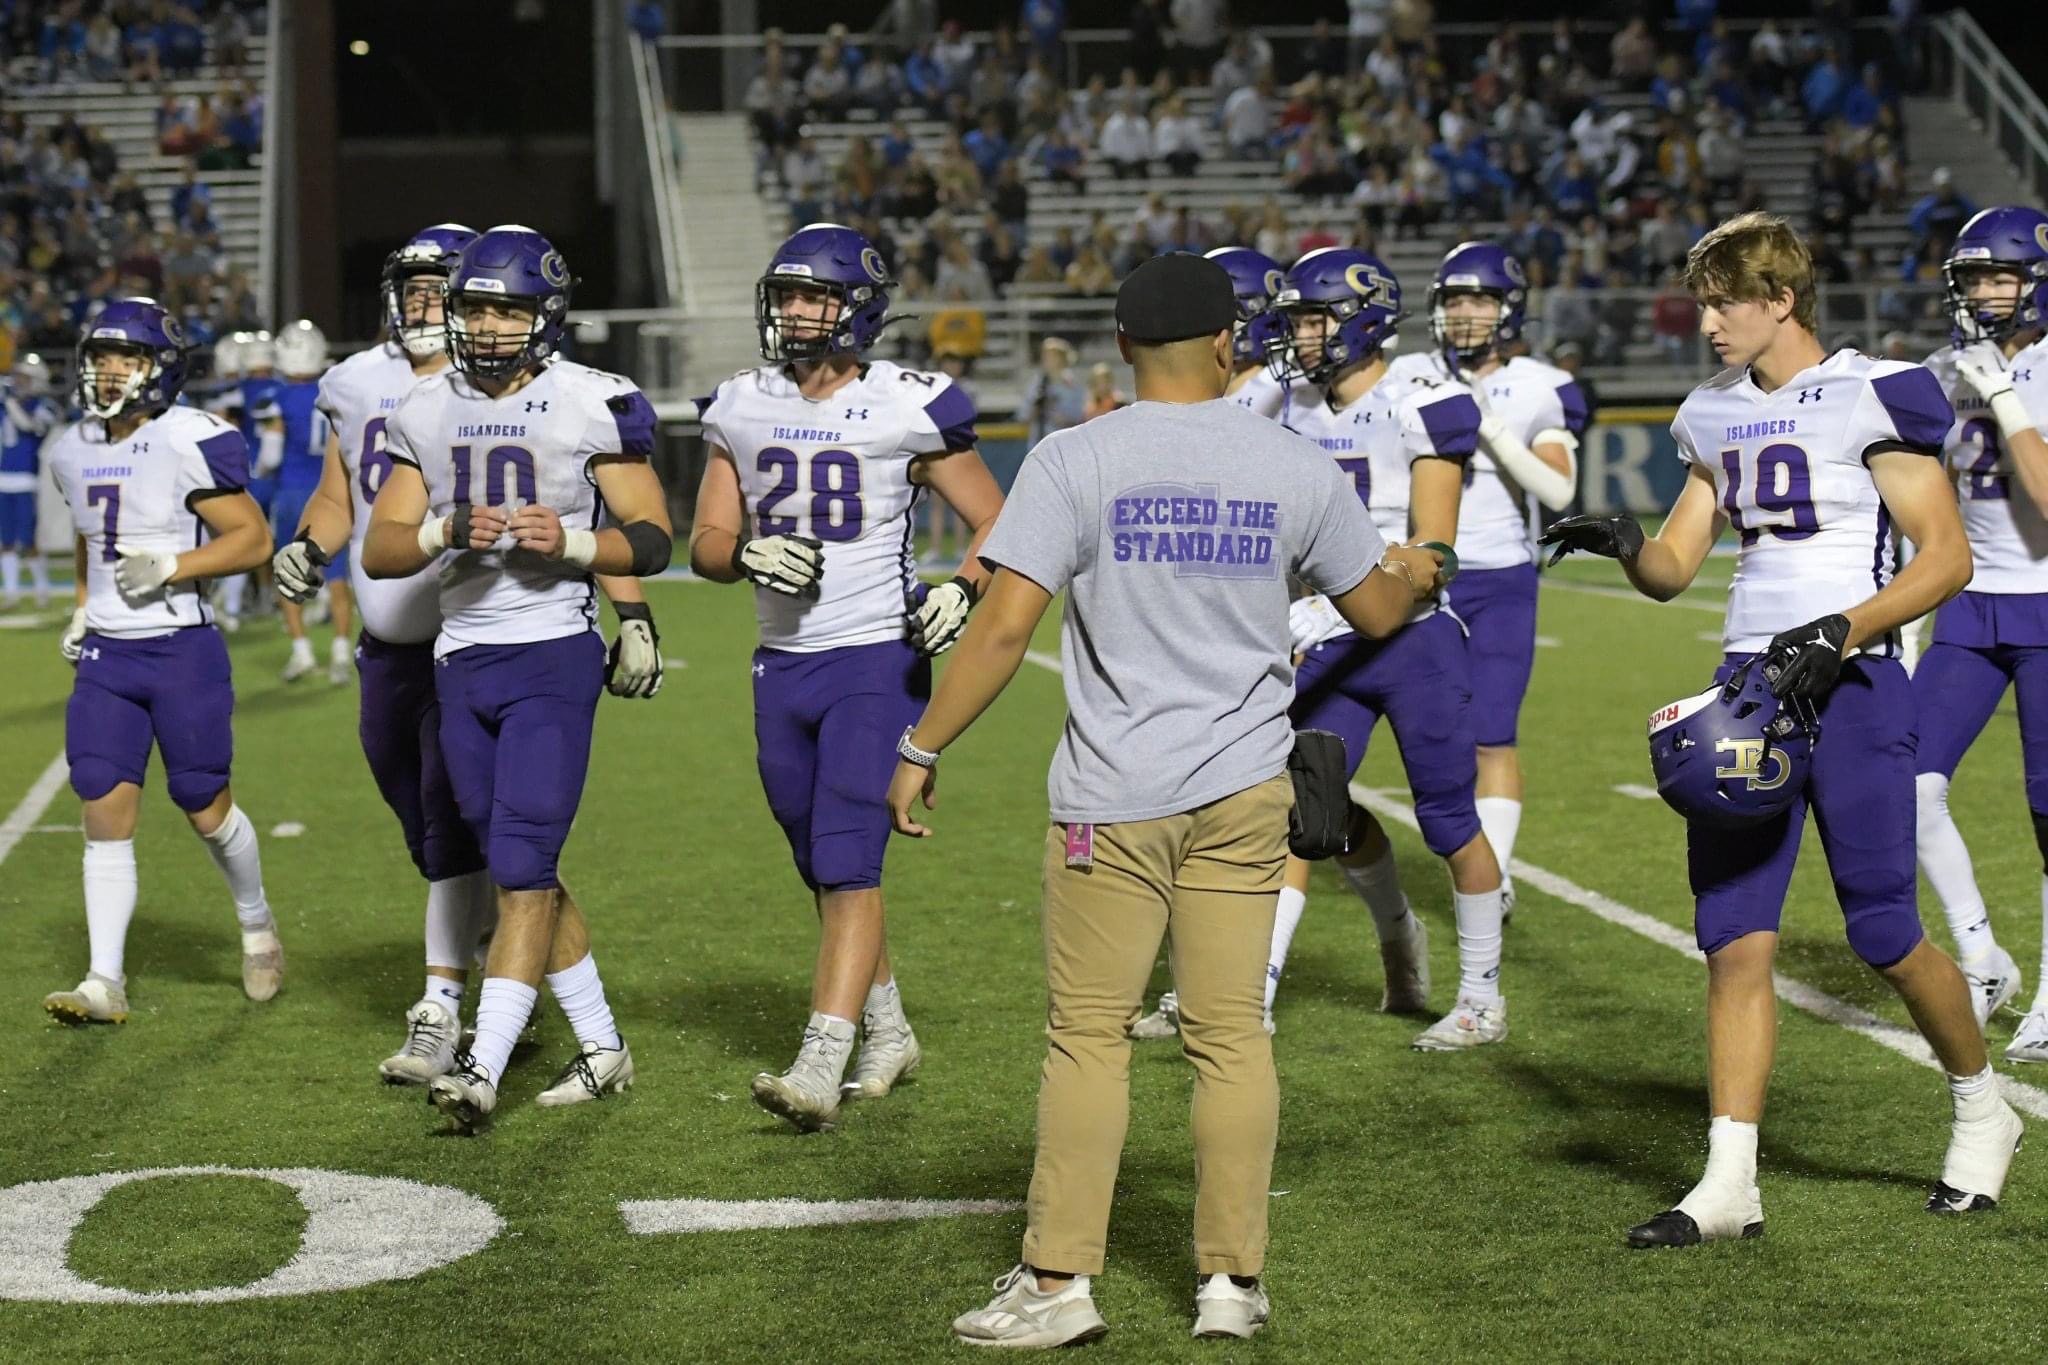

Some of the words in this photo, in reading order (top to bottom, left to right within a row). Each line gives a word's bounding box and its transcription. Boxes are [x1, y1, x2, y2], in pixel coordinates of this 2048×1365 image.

[458, 424, 527, 438] ISLANDERS
[773, 427, 842, 442] ISLANDERS
[1726, 419, 1796, 442] ISLANDERS
[83, 466, 132, 478] ISLANDERS
[451, 444, 537, 508] 10
[756, 446, 863, 542] 28
[1720, 442, 1820, 548] 19
[87, 484, 120, 563] 7
[1115, 498, 1218, 526] EXCEED
[1227, 500, 1278, 529] THE
[1114, 532, 1273, 565] STANDARD
